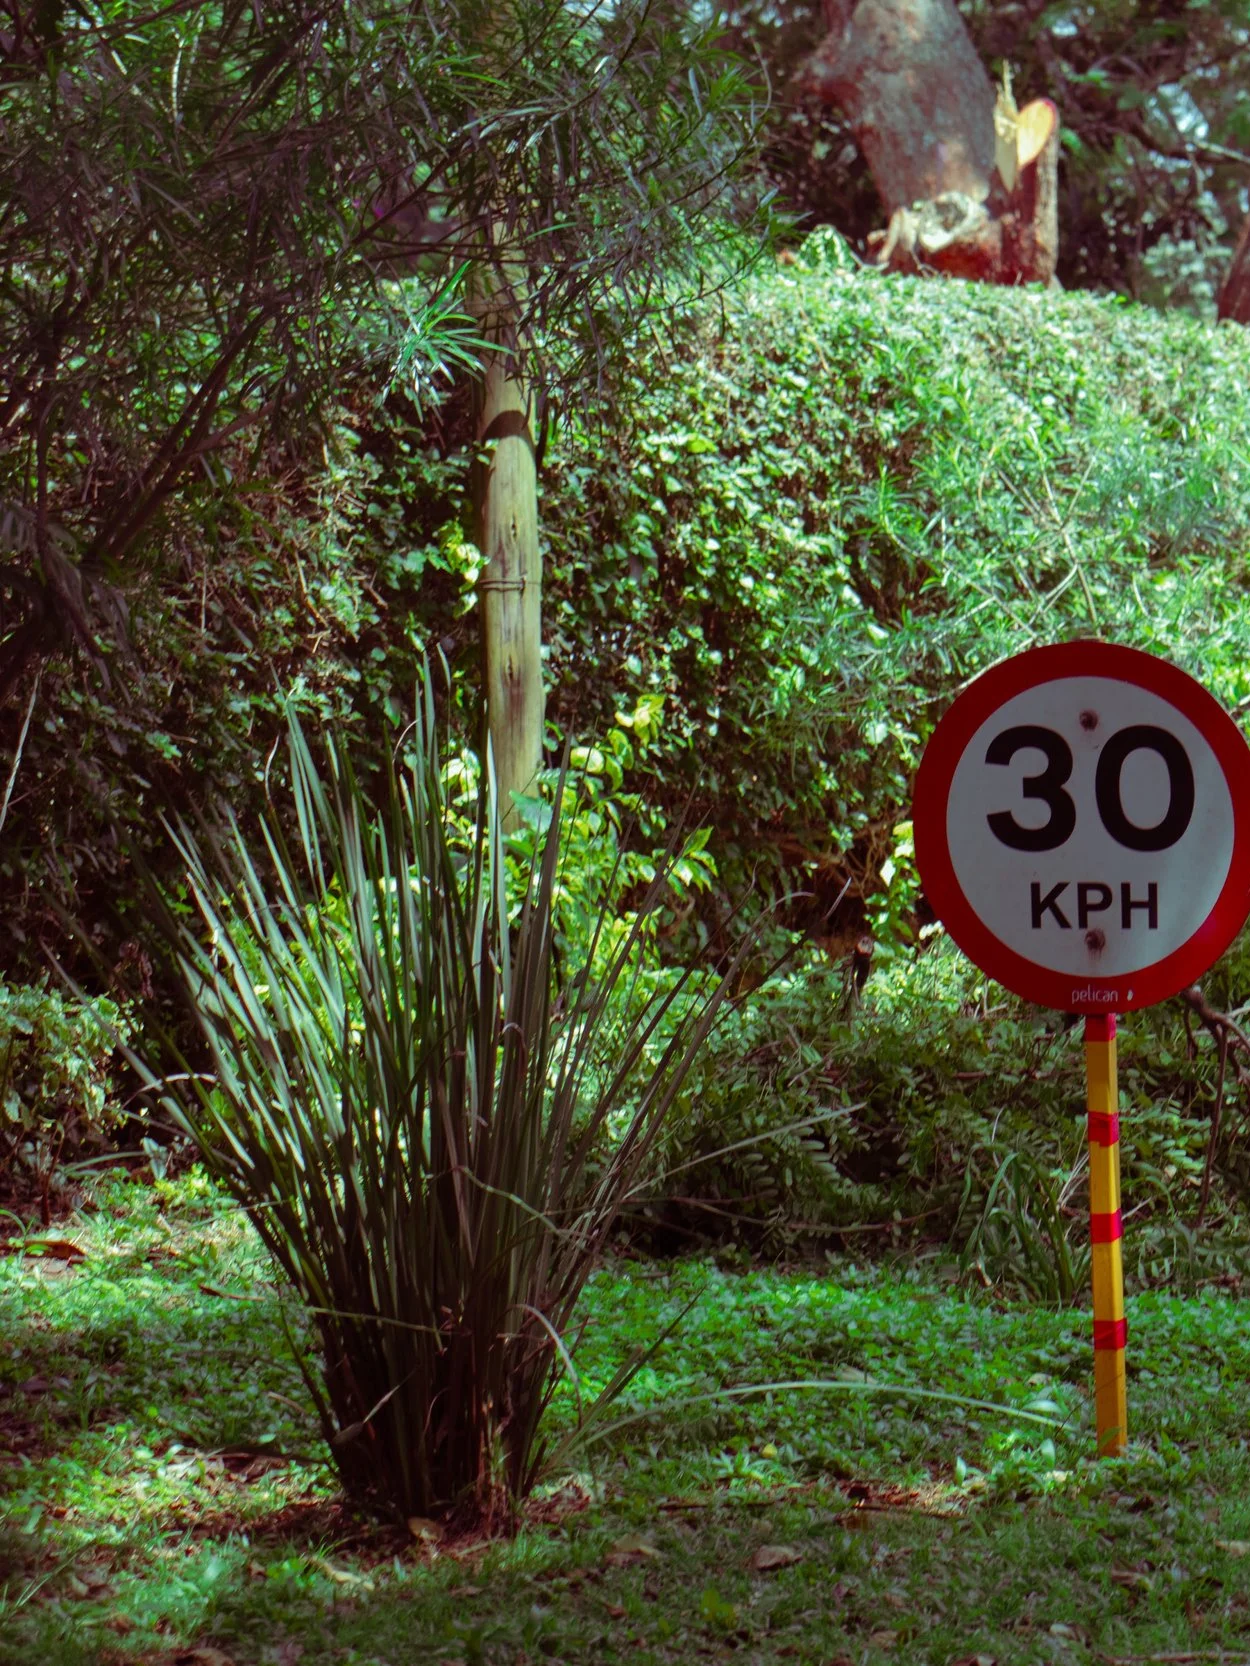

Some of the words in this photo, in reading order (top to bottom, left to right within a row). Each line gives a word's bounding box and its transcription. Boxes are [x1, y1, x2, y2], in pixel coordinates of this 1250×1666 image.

[985, 724, 1195, 853] 30
[1030, 882, 1158, 929] KPH
[1071, 984, 1119, 1004] pelican
